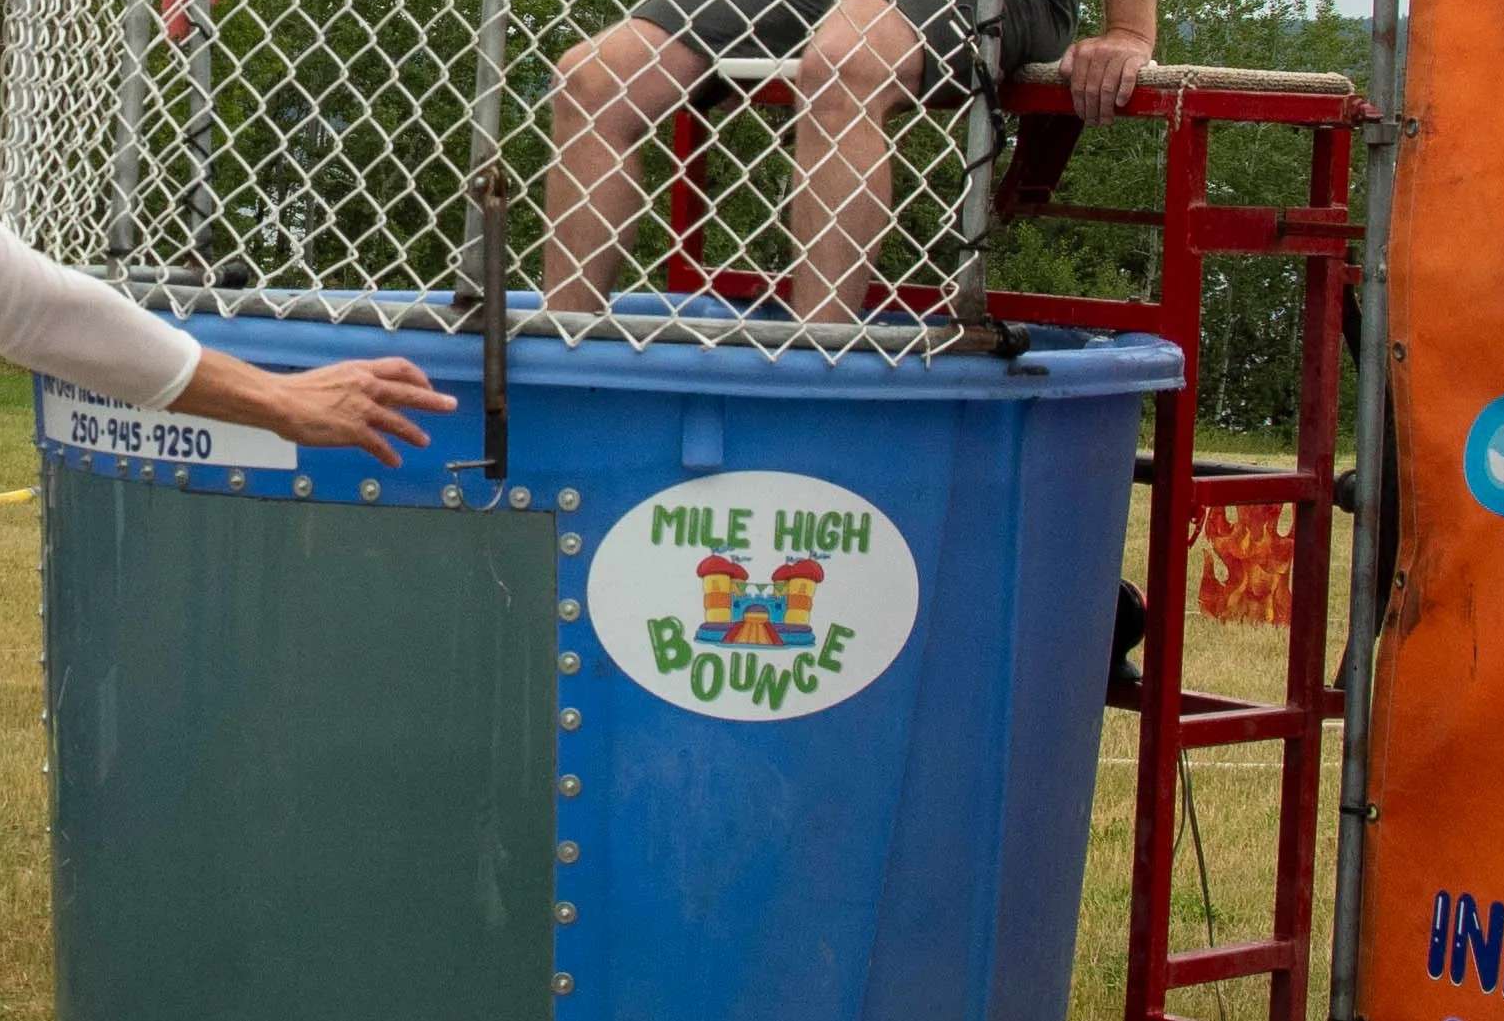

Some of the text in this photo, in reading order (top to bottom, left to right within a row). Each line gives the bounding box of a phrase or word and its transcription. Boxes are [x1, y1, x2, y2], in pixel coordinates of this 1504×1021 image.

[651, 504, 872, 554] MILE HIGH
[647, 616, 855, 711] BOUNCE
